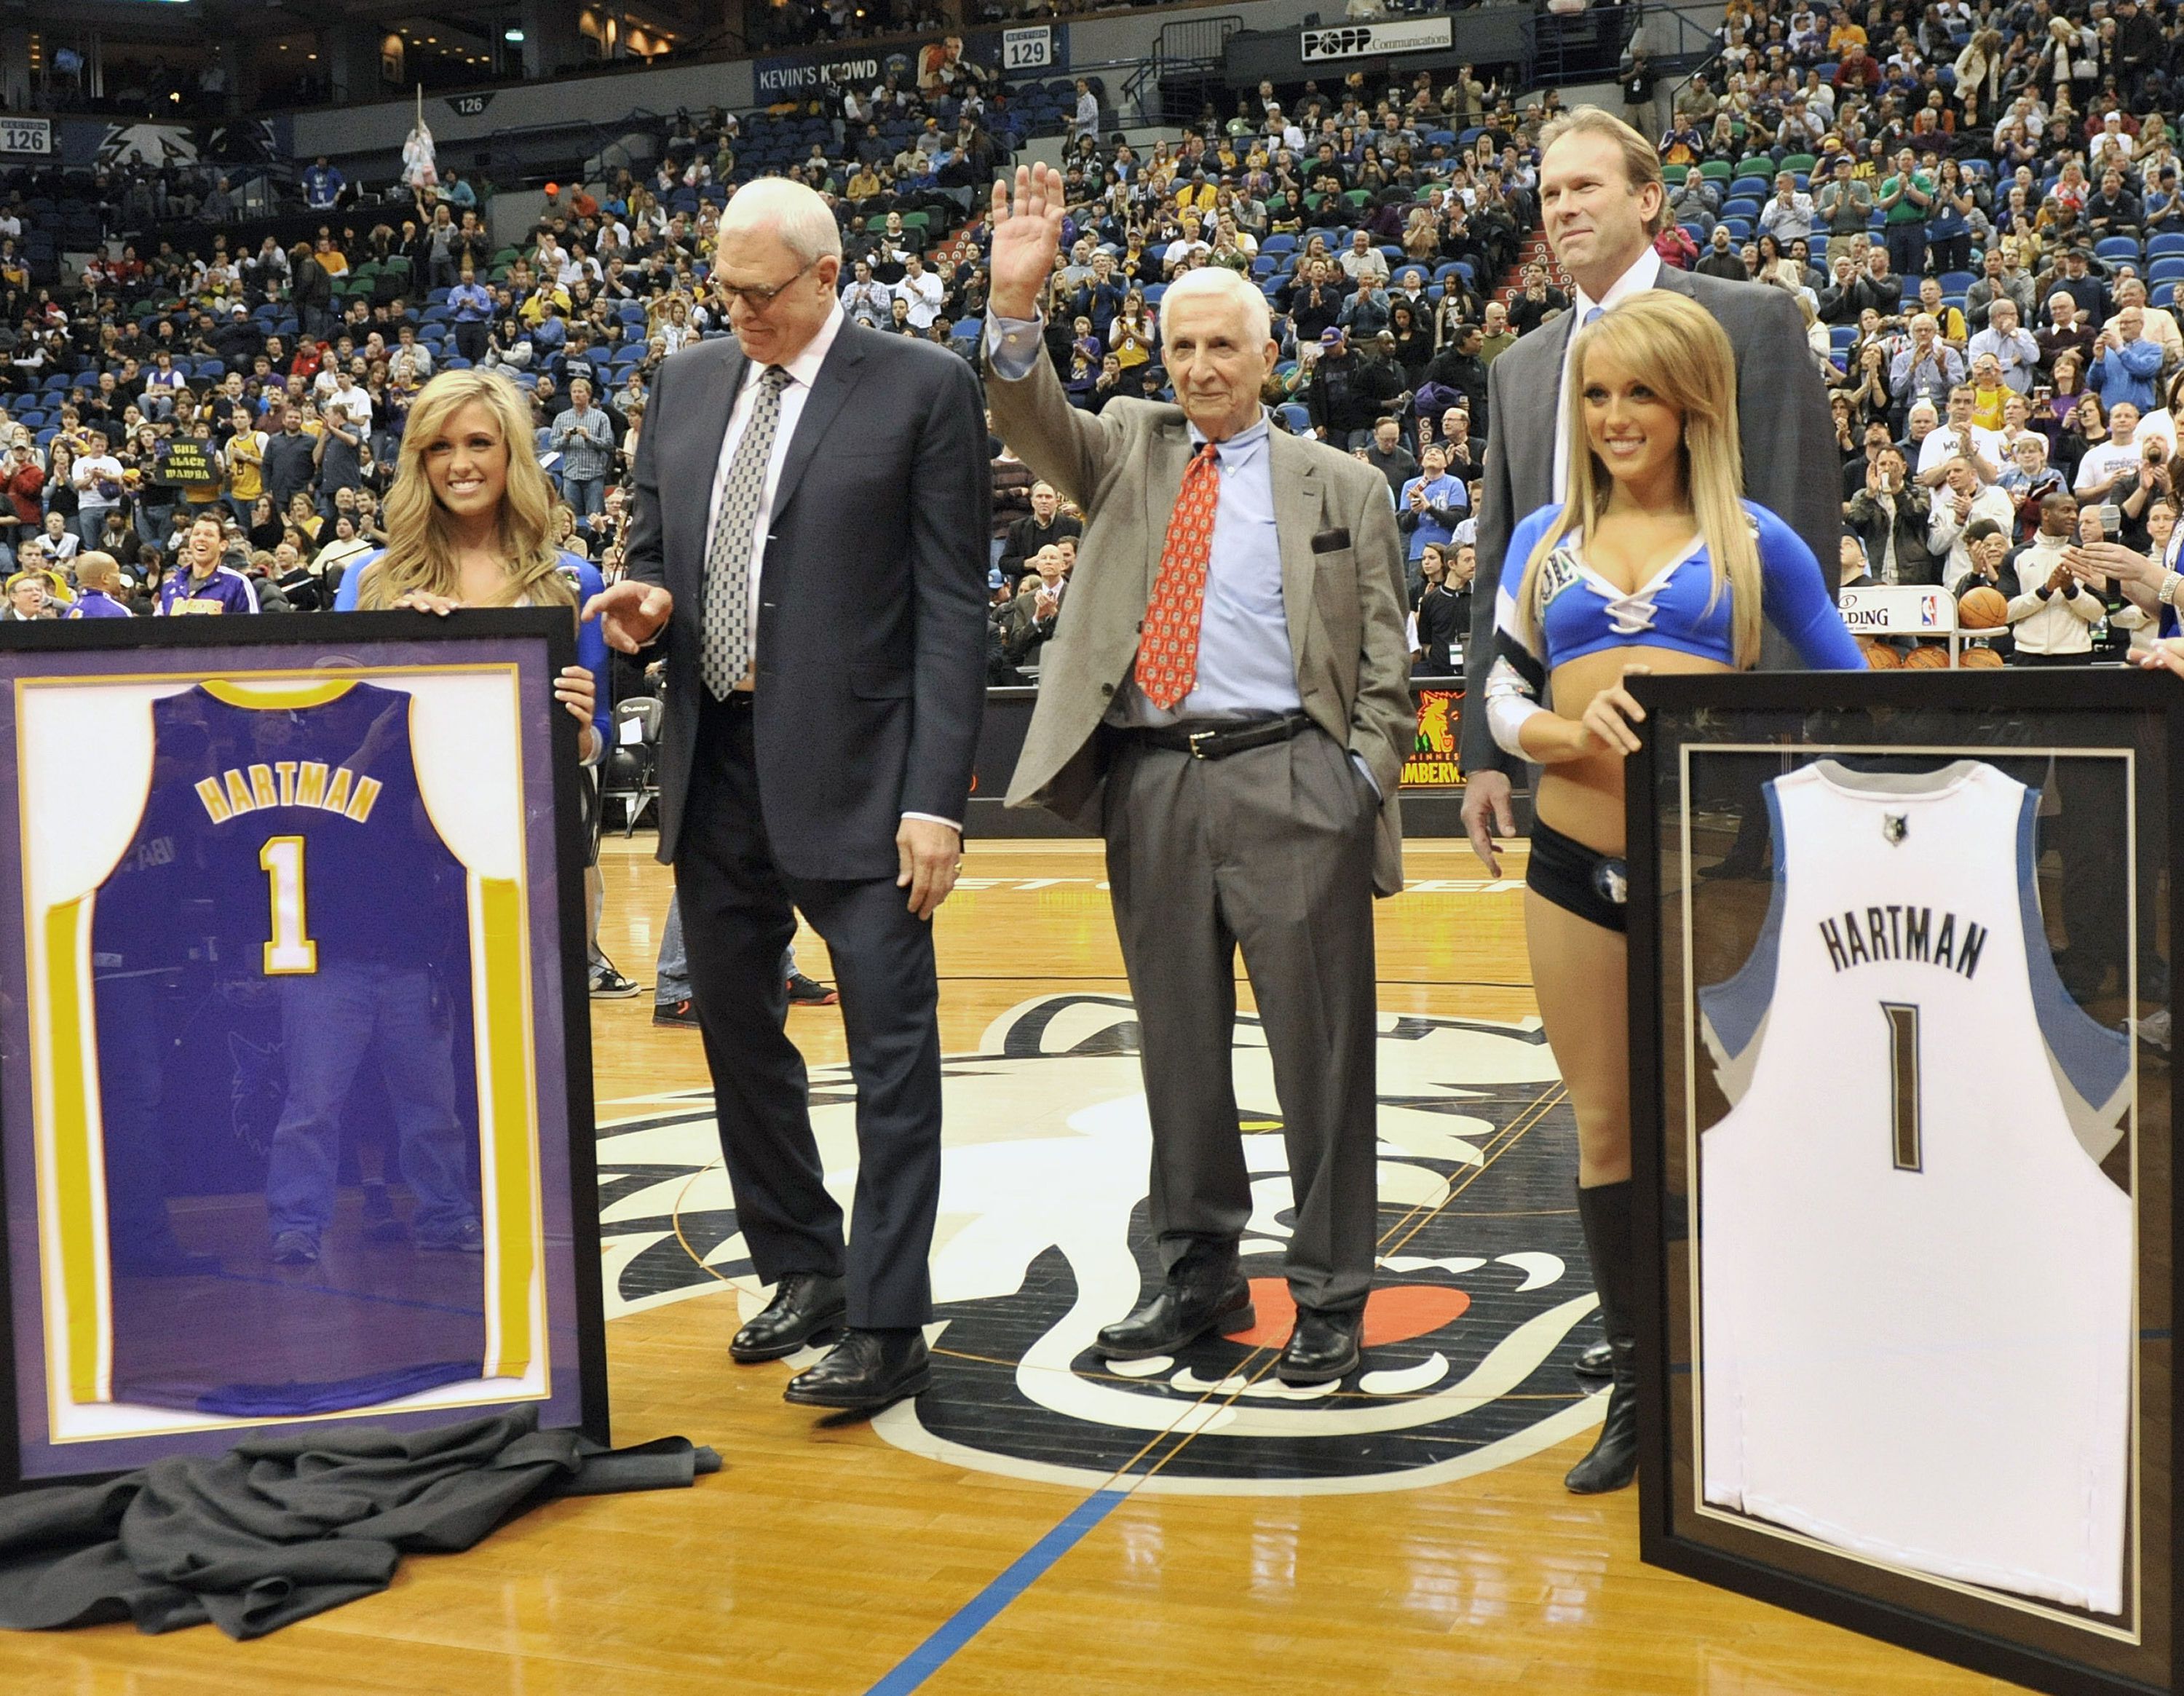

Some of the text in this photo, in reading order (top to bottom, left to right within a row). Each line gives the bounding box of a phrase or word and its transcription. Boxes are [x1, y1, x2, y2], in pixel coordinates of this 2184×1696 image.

[1305, 28, 1449, 57] POPP Communications
[1010, 42, 1044, 66] 129
[760, 66, 817, 90] KEVIN'S
[820, 59, 878, 83] KOWD
[459, 97, 483, 113] 126
[7, 130, 44, 151] 126
[1942, 207, 1950, 219] 8
[1125, 337, 1135, 351] 8
[173, 445, 199, 455] THE
[168, 457, 206, 467] BLACK
[165, 469, 210, 480] MAMBA
[194, 761, 383, 825] HARTMAN
[259, 836, 317, 975] 1
[1819, 905, 1990, 981] HARTMAN
[1879, 1000, 1924, 1175] 1
